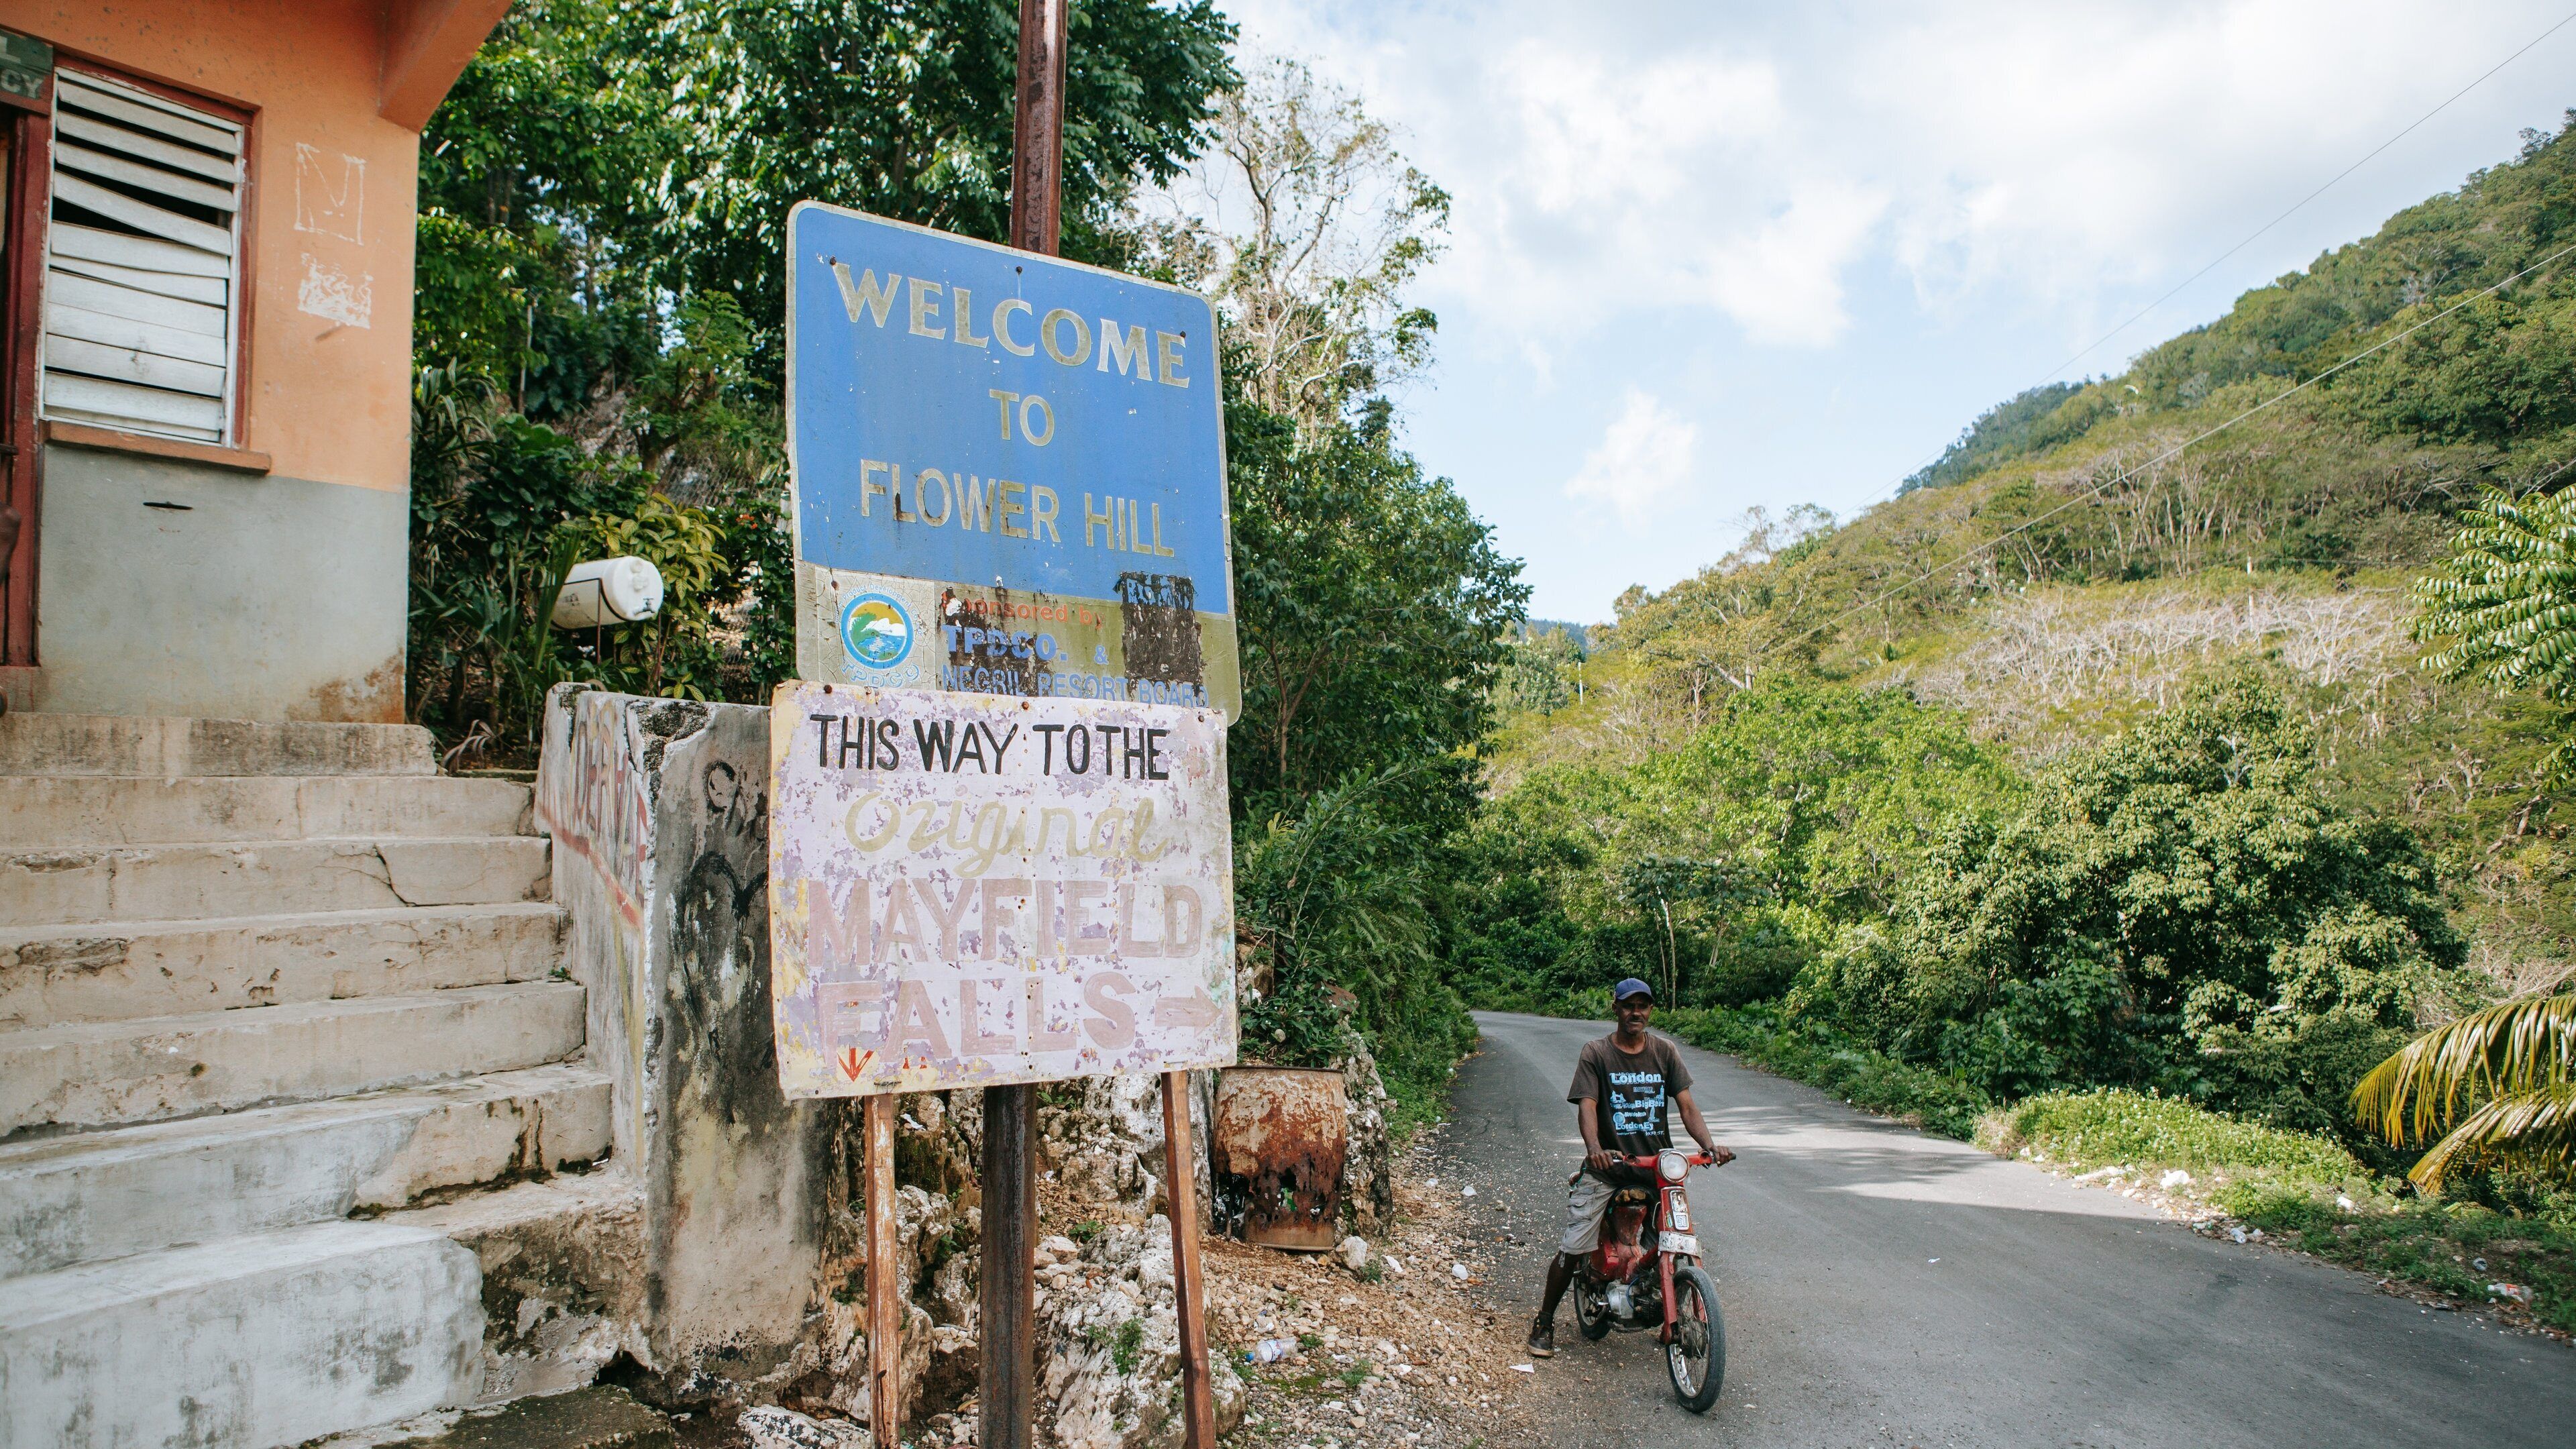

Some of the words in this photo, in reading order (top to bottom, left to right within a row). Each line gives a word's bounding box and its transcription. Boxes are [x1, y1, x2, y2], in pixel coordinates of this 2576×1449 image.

[833, 262, 1190, 388] WELCOME
[989, 389, 1055, 447] TO
[861, 459, 1061, 543] FLOWER
[1084, 492, 1175, 557] HILL
[843, 585, 867, 600] Product
[869, 583, 912, 608] Development
[1094, 645, 1109, 665] &
[943, 664, 1028, 697] NEGRIL
[1038, 672, 1128, 702] RESORT
[1138, 679, 1209, 708] BOARD
[809, 714, 900, 771] THIS
[914, 718, 1018, 775] WAY
[807, 877, 1203, 967] MAYFIELD
[819, 971, 1138, 1072] FALLS
